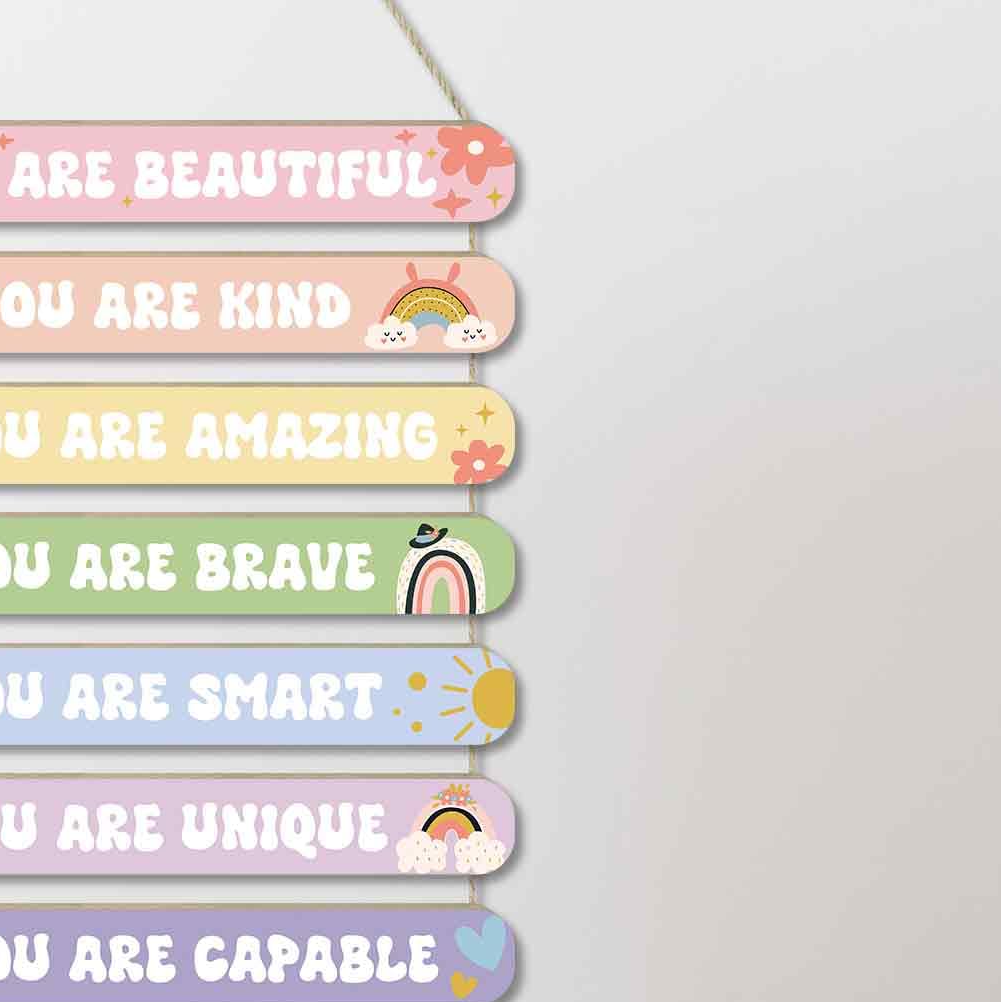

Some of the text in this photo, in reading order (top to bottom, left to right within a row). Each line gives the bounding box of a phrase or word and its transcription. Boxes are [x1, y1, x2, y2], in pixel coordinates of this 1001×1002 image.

[7, 150, 116, 199] ARE
[134, 149, 437, 200] BEAUTIFUL
[94, 281, 200, 330] ARE
[219, 281, 351, 330] KIND
[61, 411, 167, 460] ARE
[186, 411, 436, 460] AMAZING
[69, 542, 176, 591] ARE
[195, 542, 375, 591] BRAVE
[62, 672, 169, 721] ARE
[188, 672, 382, 721] SMART
[56, 803, 164, 852] ARE
[180, 803, 388, 858] UNIQUE
[69, 933, 177, 983] ARE
[193, 933, 440, 984] CAPABLE
